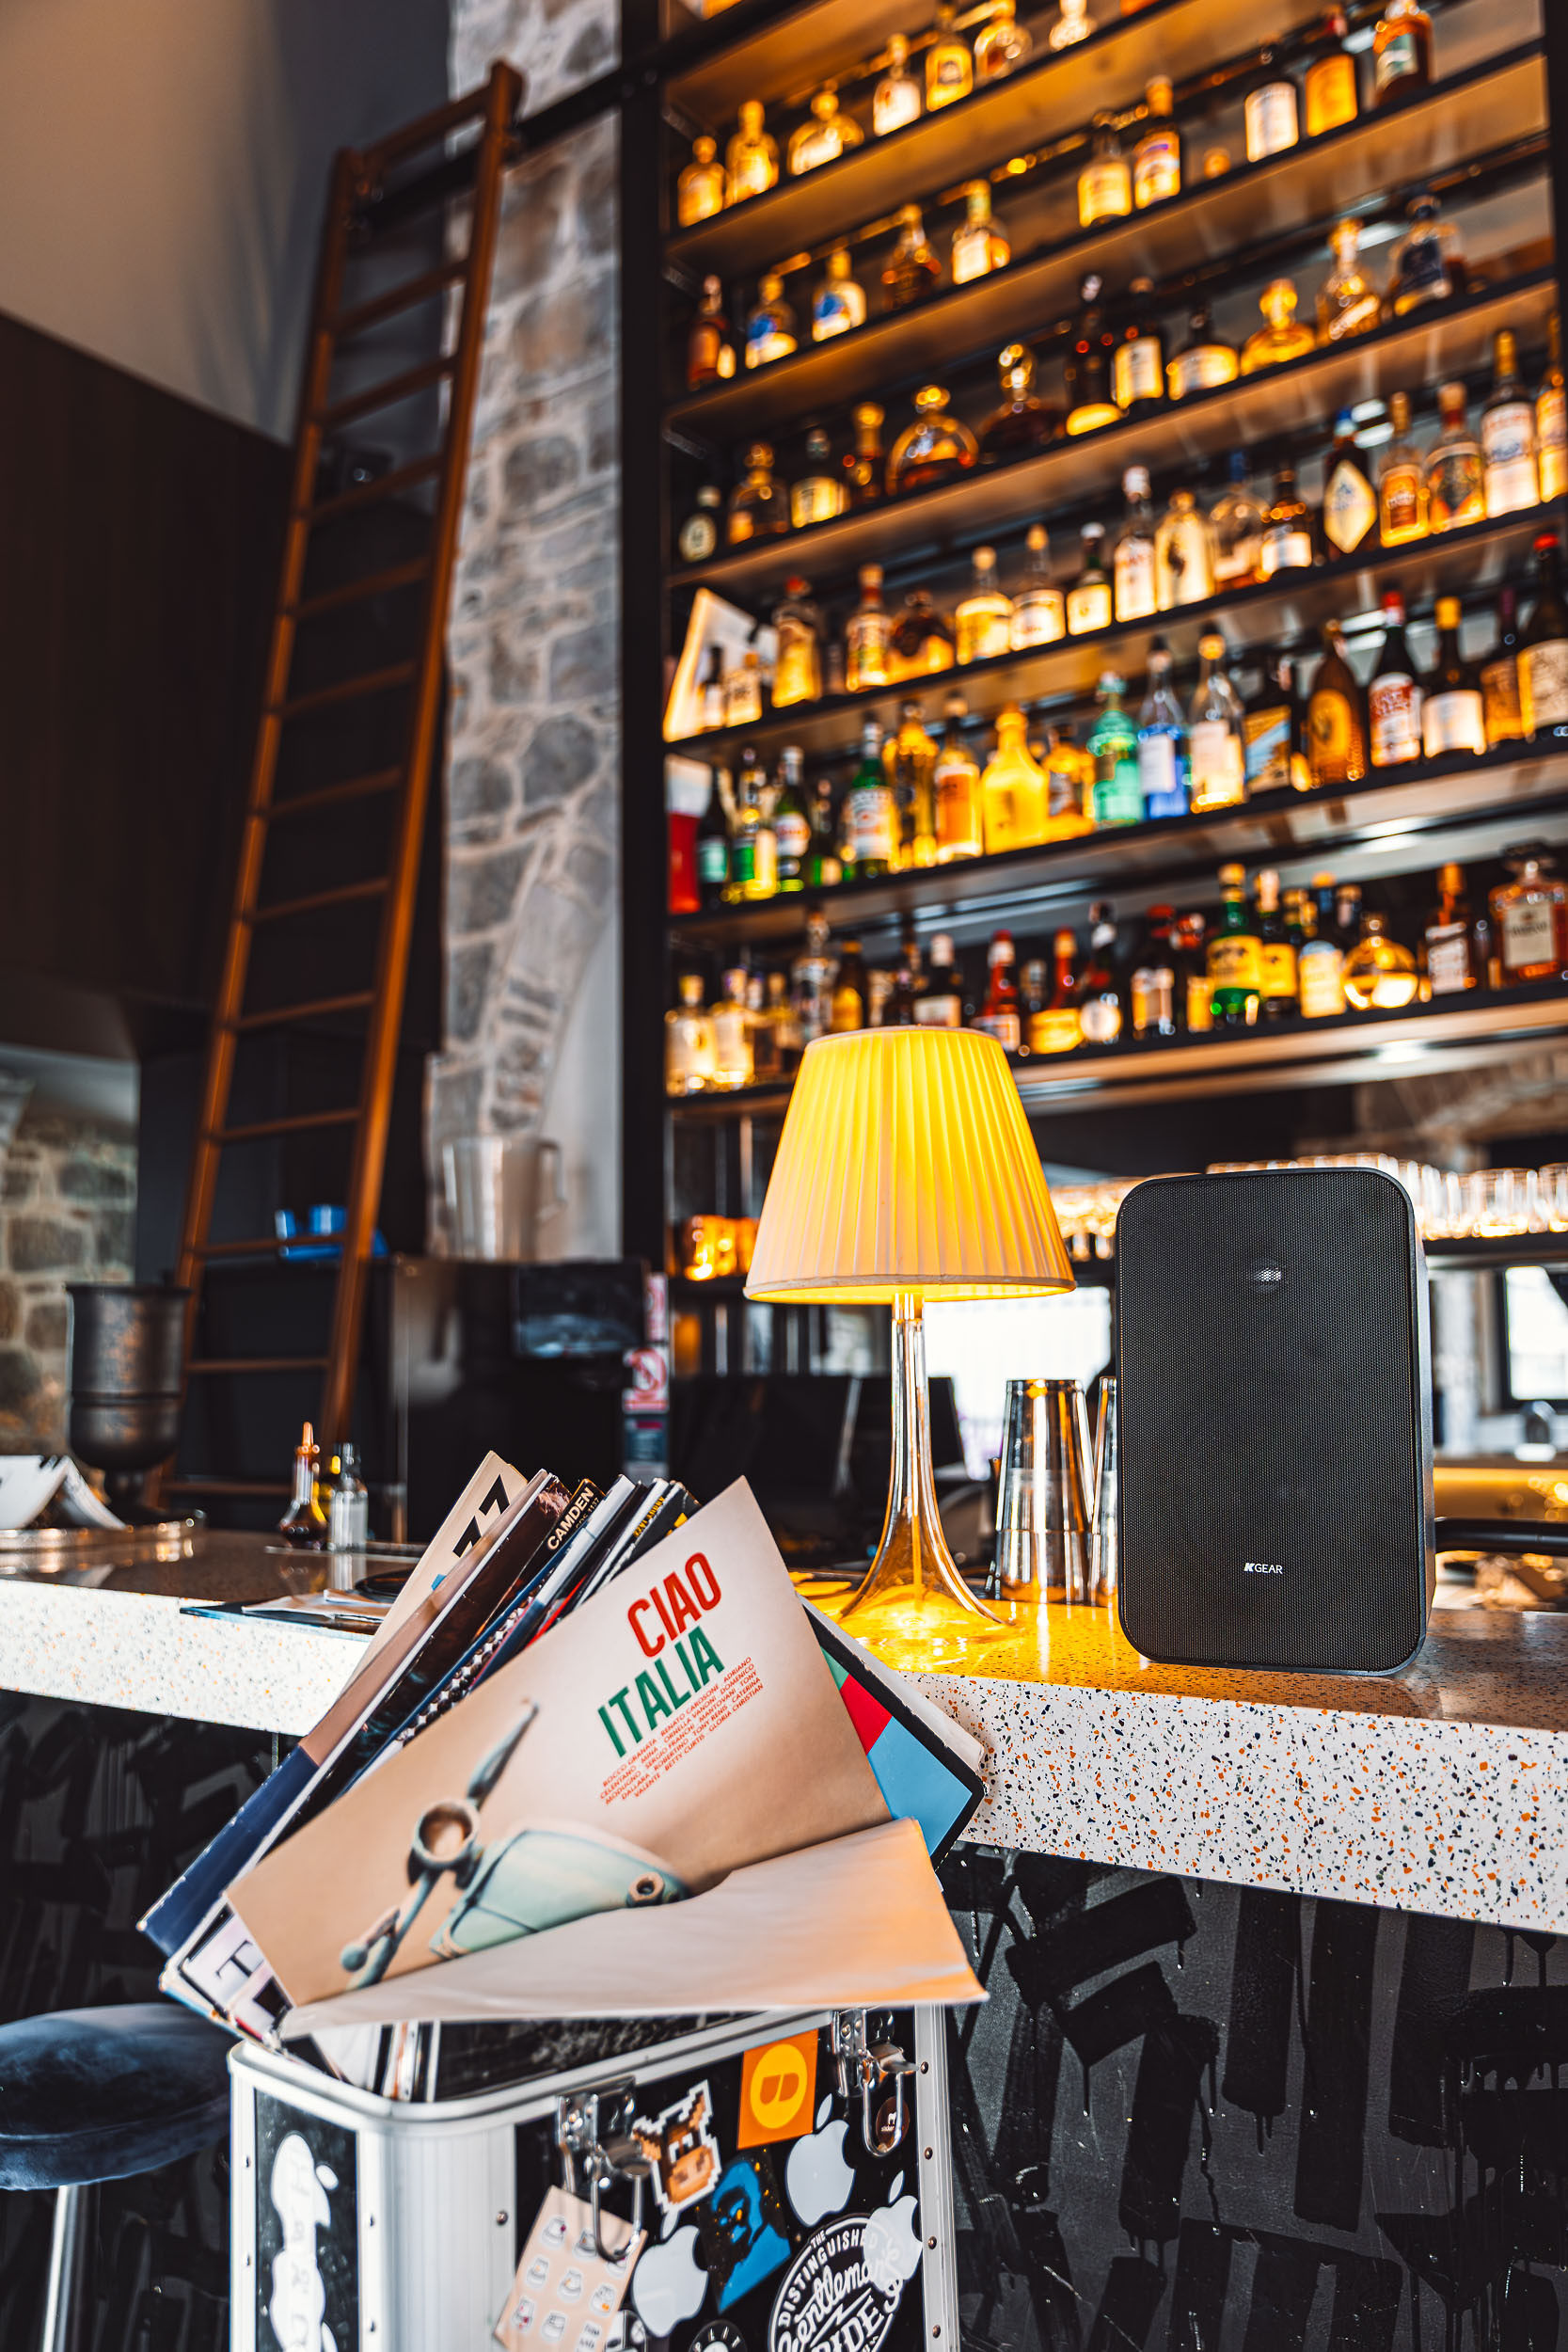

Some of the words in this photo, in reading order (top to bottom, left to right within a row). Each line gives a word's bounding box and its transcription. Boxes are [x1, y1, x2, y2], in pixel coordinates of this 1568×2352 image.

[547, 1486, 594, 1550] CAMDEN
[627, 1552, 721, 1658] CIAO
[597, 1626, 725, 1757] ITALIA
[600, 1766, 637, 1799] CELENTANO
[641, 1747, 658, 1763] MINA
[664, 1719, 691, 1743] ORNELLA
[692, 1697, 716, 1718] VANONI
[721, 1663, 754, 1694] DOMENICO
[603, 1765, 626, 1787] ROCCO
[628, 1739, 657, 1764] GRANATA
[660, 1714, 685, 1737] RENATO
[687, 1684, 719, 1714] CAROSONE
[723, 1657, 752, 1682] ADRIANO
[606, 1771, 641, 1804] MODUGNO
[645, 1748, 667, 1769] SERGIO
[669, 1724, 694, 1748] FRANCHI
[699, 1690, 736, 1723] MANTOVANI
[739, 1671, 757, 1686] TONY
[622, 1773, 650, 1800] DALLARA
[654, 1738, 689, 1771] ROBERTINO
[692, 1721, 710, 1737] TONY
[711, 1706, 727, 1721] RENIS
[732, 1677, 761, 1704] CATERINA
[634, 1773, 660, 1798] VALENTE
[665, 1754, 682, 1771] BETTY
[684, 1735, 705, 1753] CURTIS
[709, 1711, 732, 1731] GLORIA
[732, 1683, 764, 1711] CHRISTIAN
[811, 2230, 826, 2249] THE
